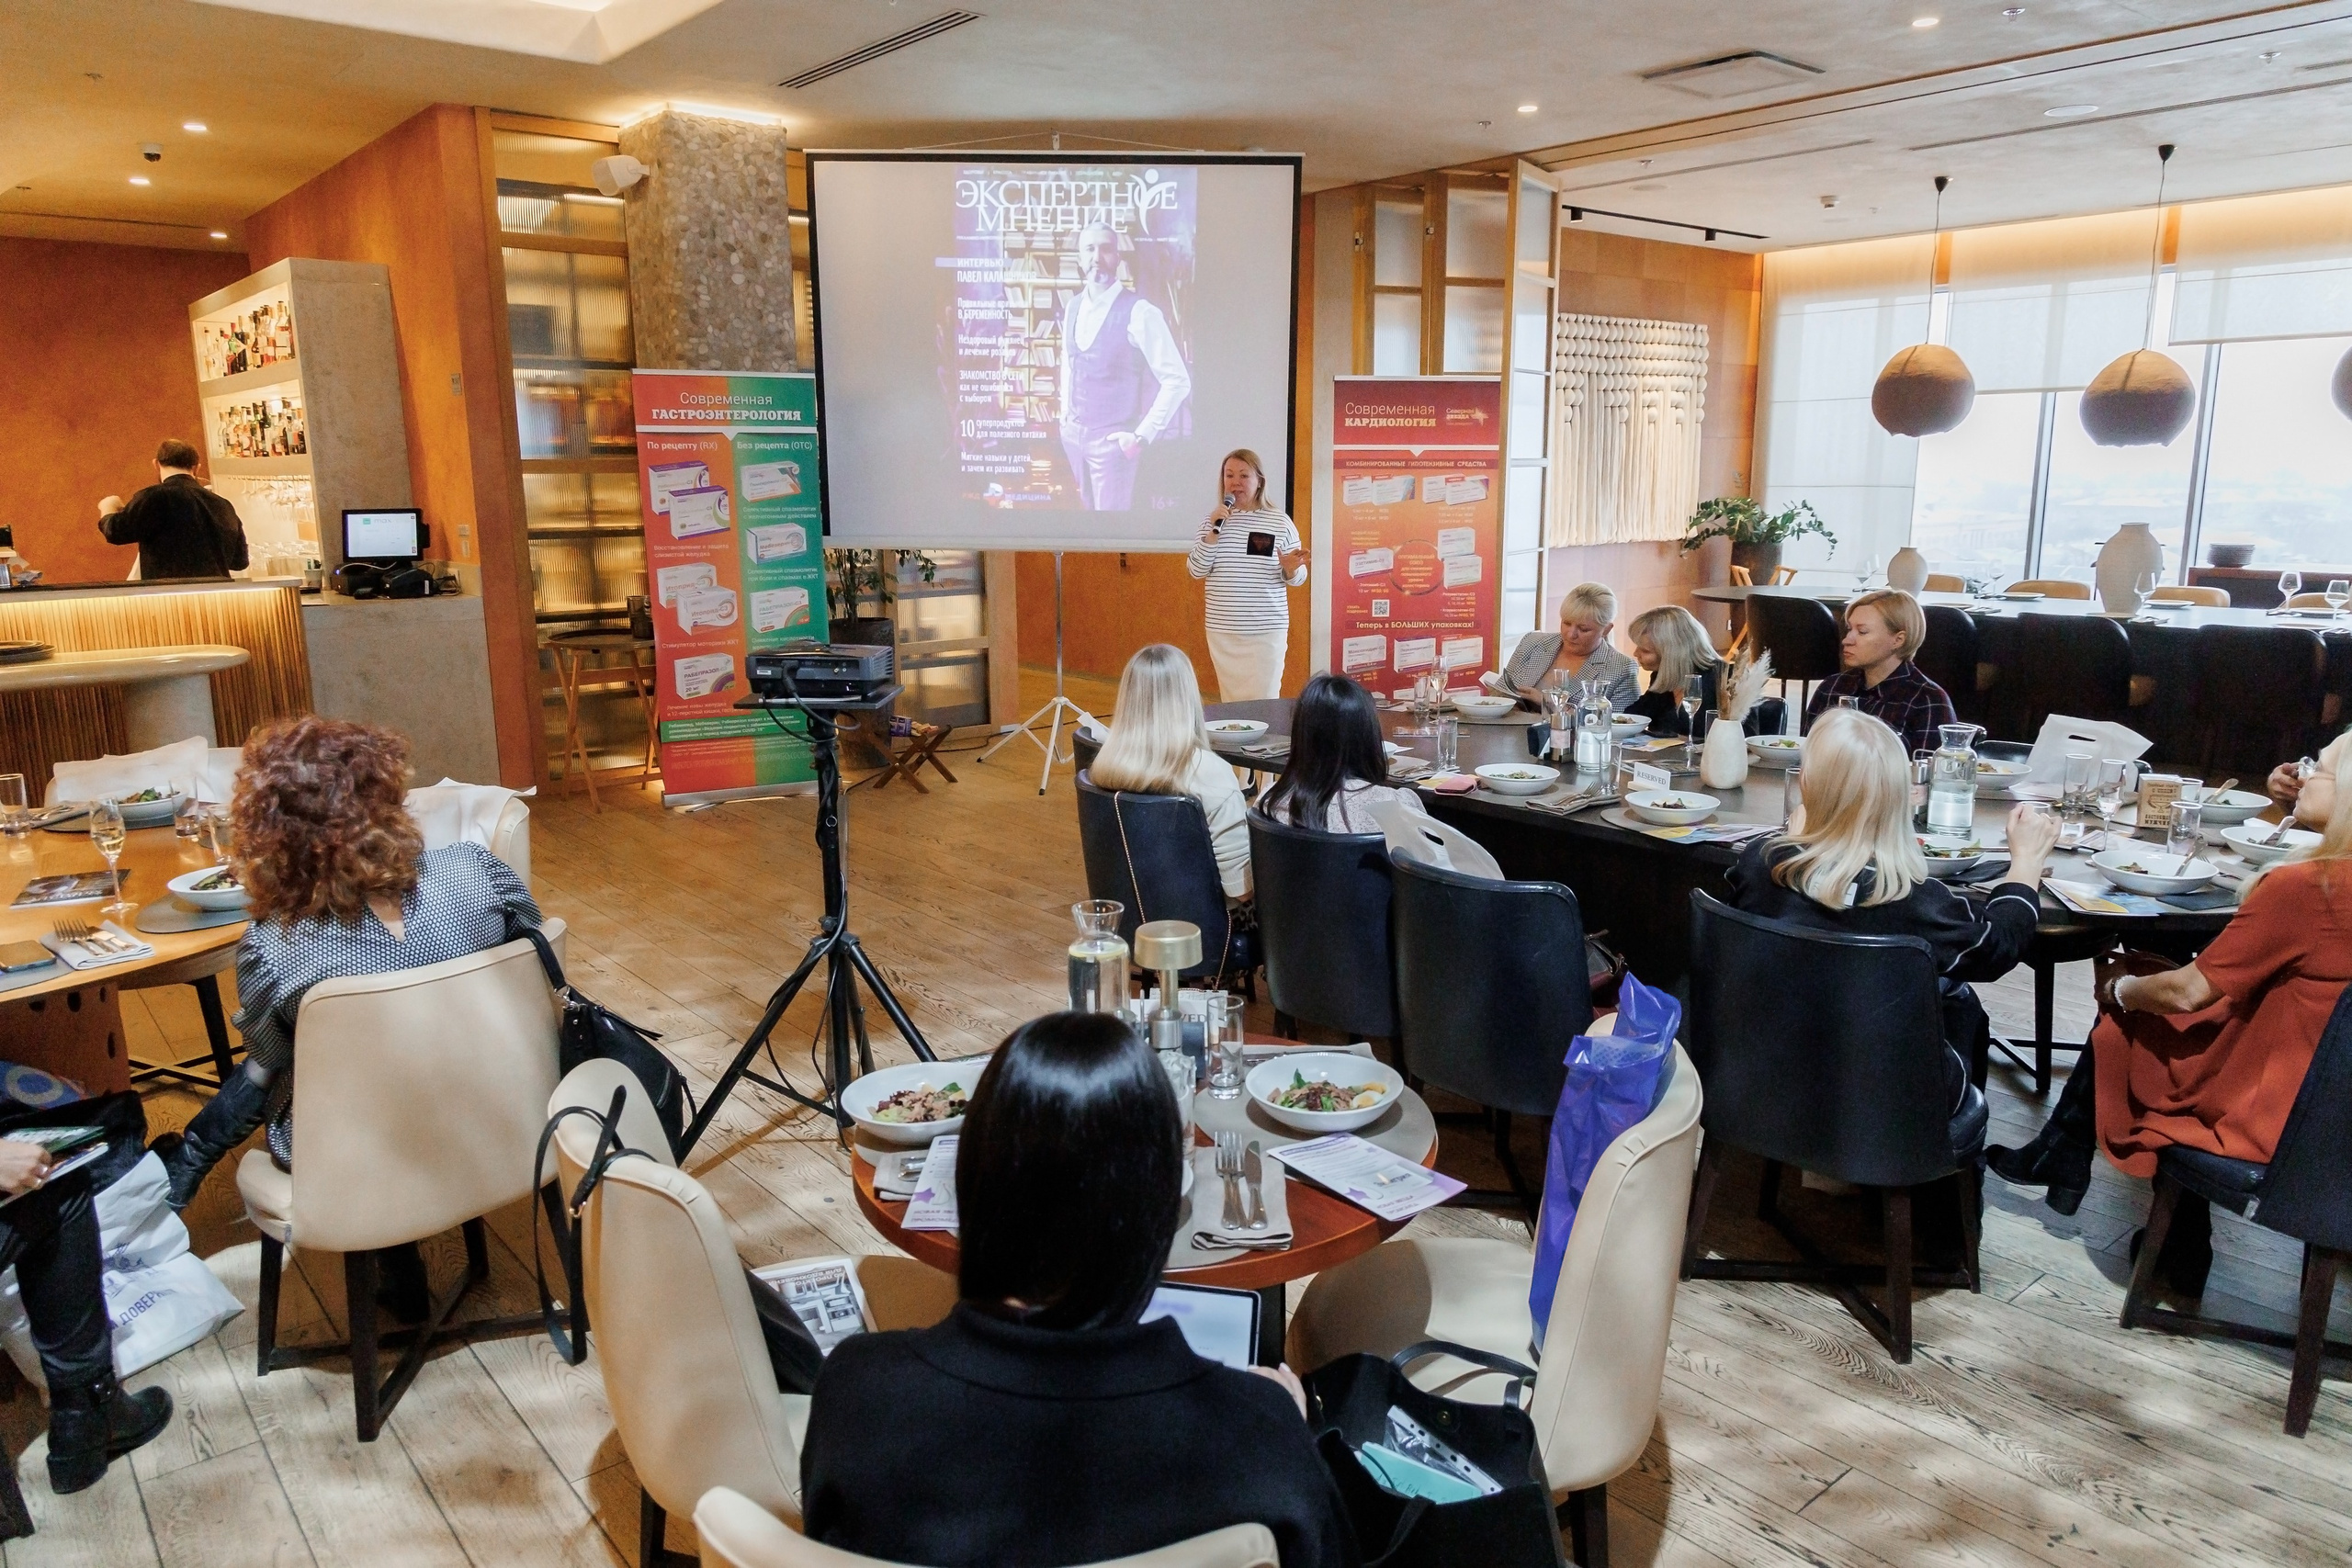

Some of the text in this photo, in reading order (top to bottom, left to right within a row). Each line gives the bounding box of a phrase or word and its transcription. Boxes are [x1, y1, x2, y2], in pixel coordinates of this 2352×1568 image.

[956, 178, 1179, 209] ЭКСПЕРТНОЕ
[976, 206, 1128, 233] МНЕНИЕ
[957, 258, 1004, 267] ИНТЕРВЬЮ
[957, 271, 982, 283] ПАВЕЛ
[957, 298, 996, 309] Правильные
[964, 310, 1012, 320] БЕРЕМЕННОСТЬ
[958, 334, 996, 345] Нездоровый
[959, 370, 1001, 381] ЗНАКОМСТВО
[680, 391, 773, 407] Современная
[965, 393, 992, 404] выбором
[1345, 401, 1435, 417] Современная
[651, 409, 802, 422] ГАСТРОЭНТЕРОЛОГИЯ
[960, 419, 1024, 437] 10 суперпродуктов
[1344, 418, 1437, 428] КАРДИОЛОГИЯ
[976, 431, 1046, 439] для полезного питания
[647, 441, 718, 452] По рецепту (RX)
[737, 442, 813, 452] Без рецепта (OTC)
[961, 452, 983, 462] Мягкие
[984, 454, 1007, 462] навыки
[994, 466, 1025, 475] развивать
[1004, 492, 1052, 501] МЕДИЦИНА
[1356, 621, 1383, 630] Теперь
[1431, 620, 1475, 630] упаковках!
[662, 639, 696, 649] Стимулятор
[697, 639, 726, 648] моторики
[1636, 770, 1667, 785] RESERVED
[766, 1271, 823, 1285] ВДОХНОВЕНИ
